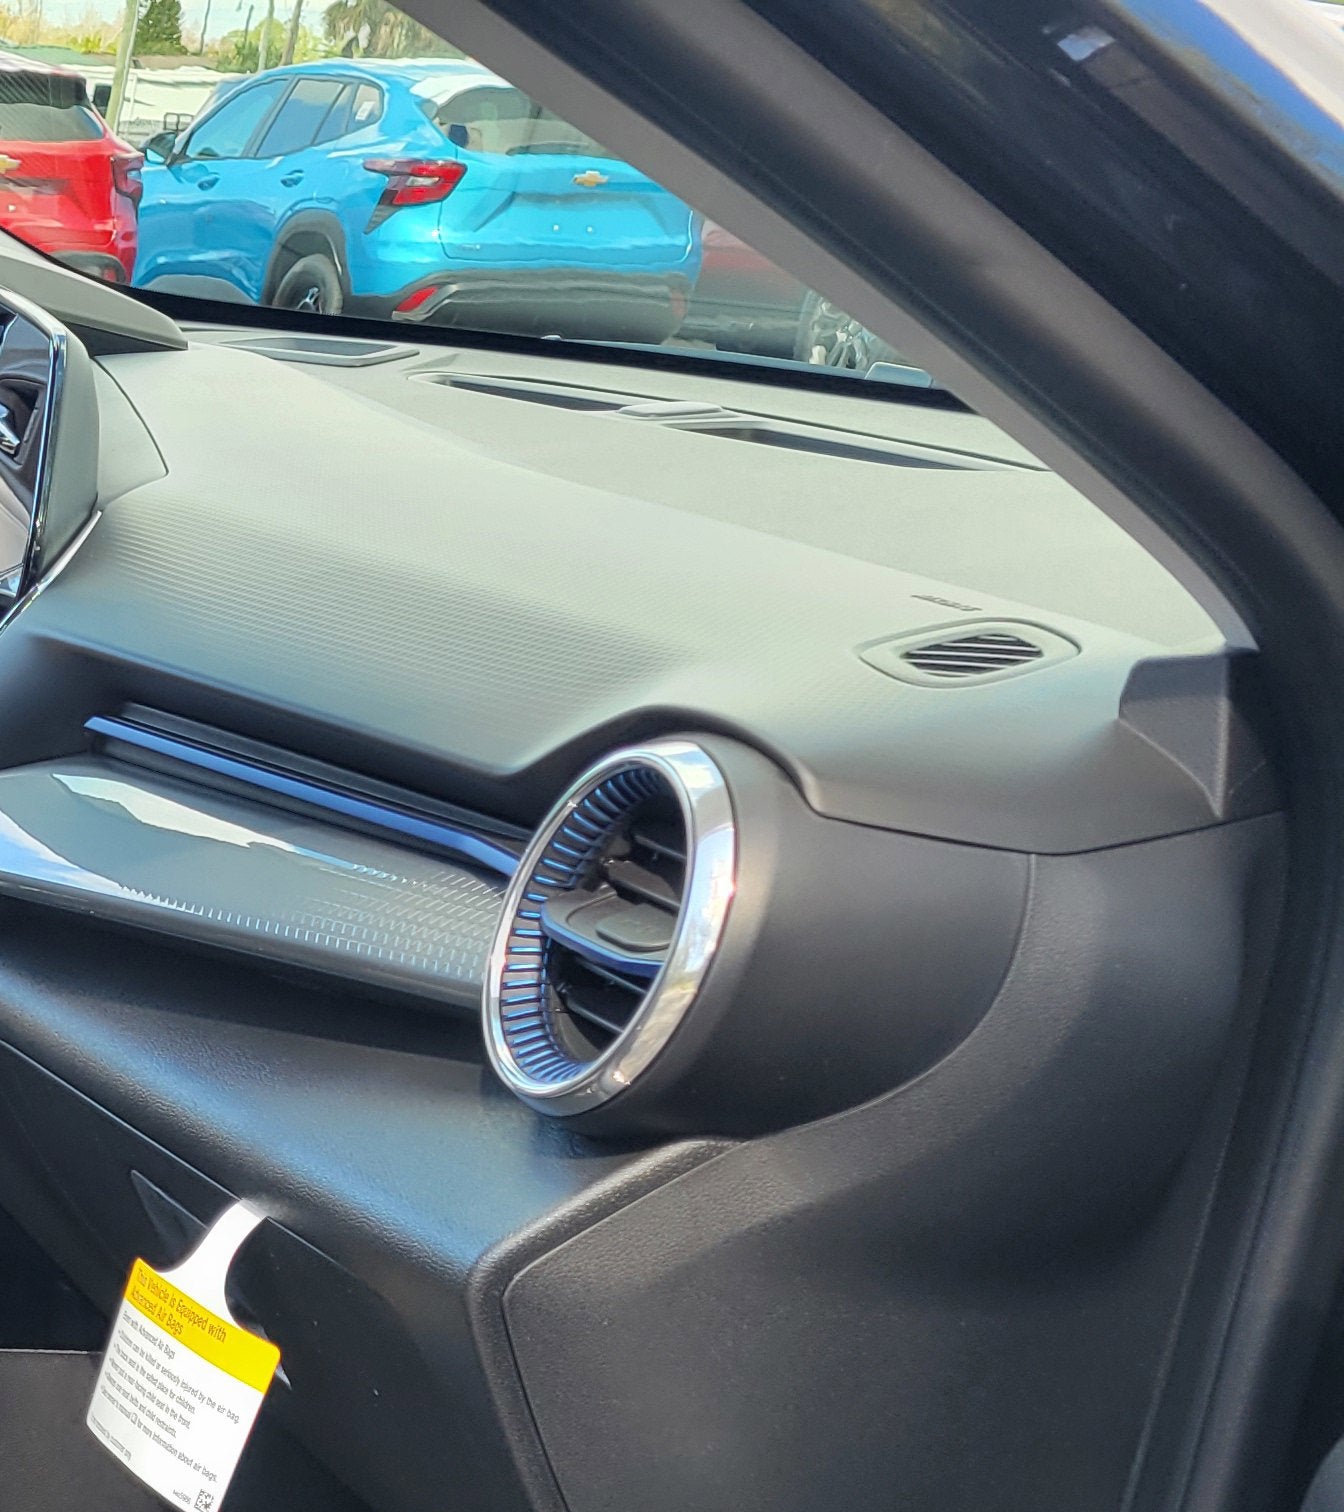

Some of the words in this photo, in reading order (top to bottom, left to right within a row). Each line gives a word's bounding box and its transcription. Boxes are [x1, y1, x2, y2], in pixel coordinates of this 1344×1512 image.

[166, 1314, 183, 1335] Bags
[176, 1299, 208, 1330] Equipped
[208, 1324, 226, 1342] with
[206, 1397, 216, 1408] the
[226, 1409, 239, 1424] bag.
